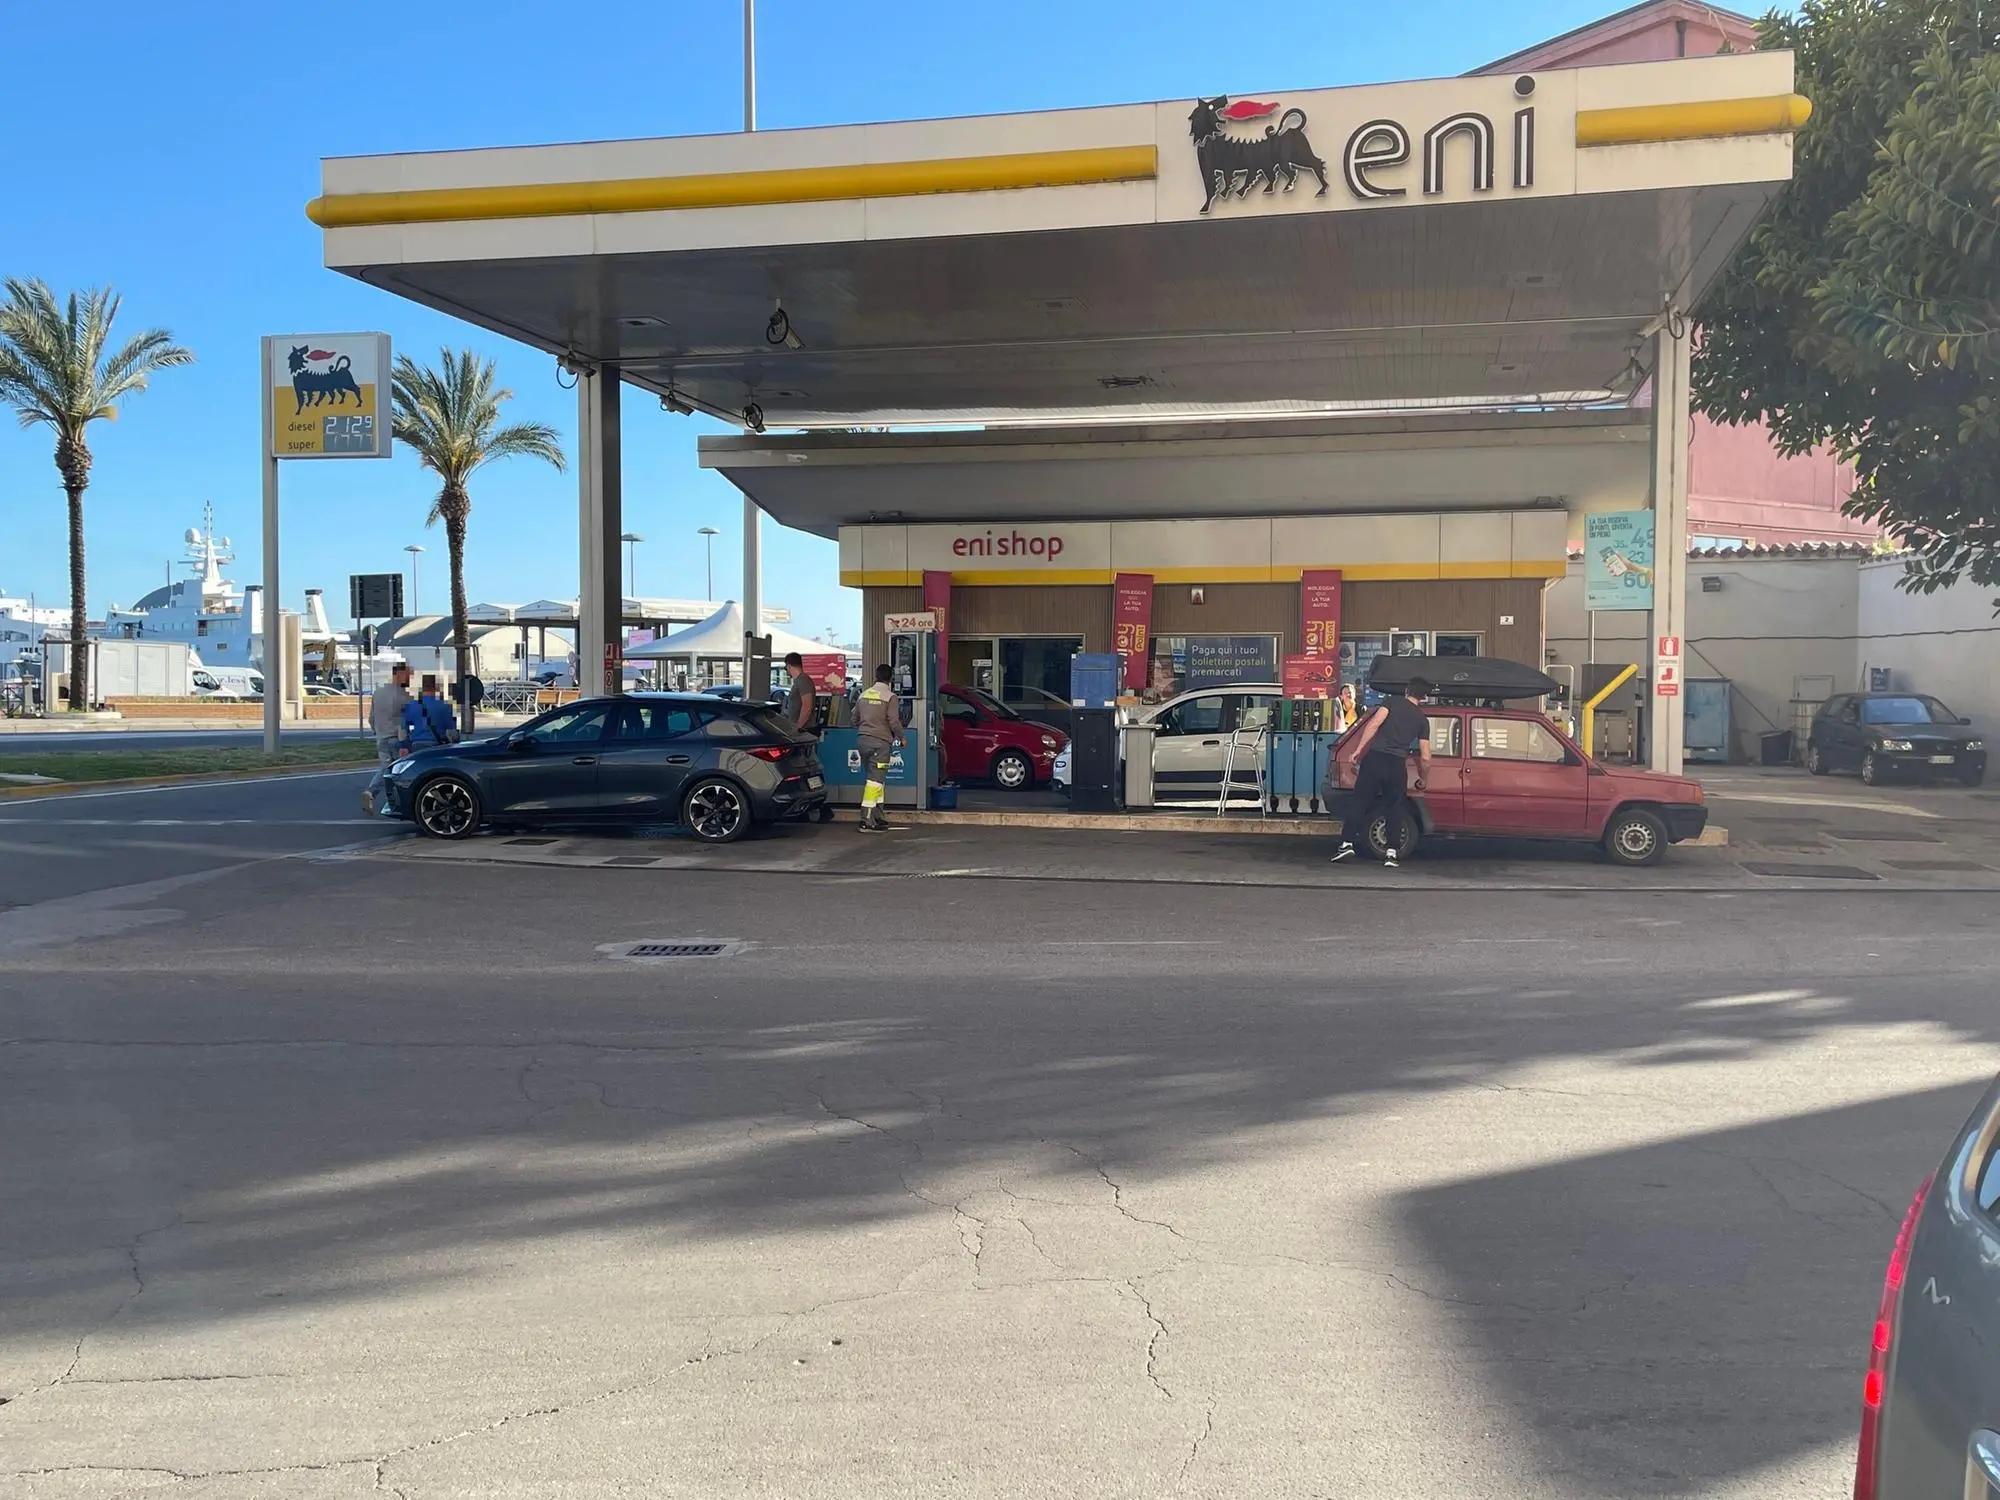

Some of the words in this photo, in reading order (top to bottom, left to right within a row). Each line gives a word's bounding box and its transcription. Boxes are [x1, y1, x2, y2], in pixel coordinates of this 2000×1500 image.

[1344, 75, 1536, 200] eni
[288, 420, 315, 431] diesel
[288, 441, 315, 451] super
[902, 617, 917, 628] 24
[1326, 621, 1335, 648] Point
[1191, 645, 1216, 656] Paga
[1217, 645, 1233, 655] qui
[1240, 646, 1259, 654] tuoi
[1191, 656, 1233, 666] bollettini
[1234, 657, 1266, 668] postali
[1191, 667, 1242, 678] premarcati
